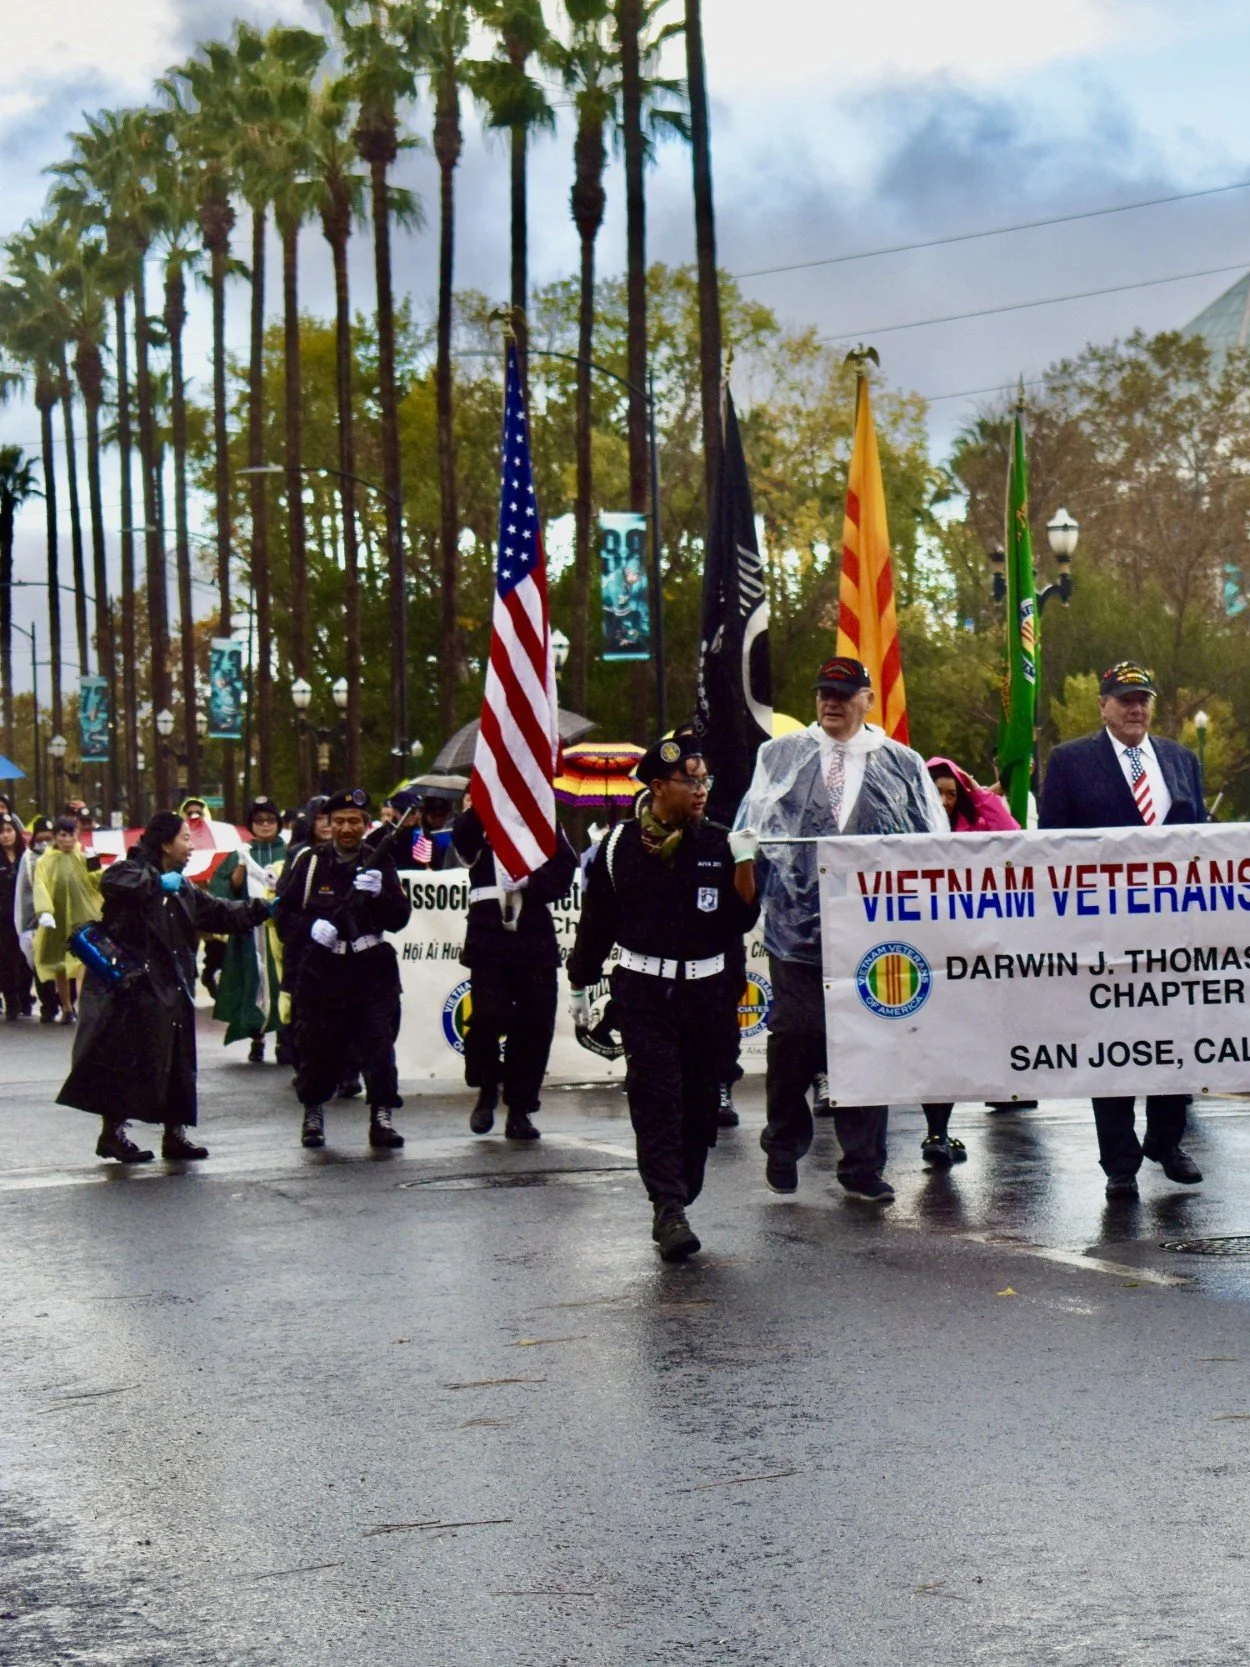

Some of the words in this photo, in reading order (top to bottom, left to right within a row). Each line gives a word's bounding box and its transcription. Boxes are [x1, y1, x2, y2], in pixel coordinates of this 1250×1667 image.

[401, 878, 470, 911] Associ
[857, 866, 1035, 922] VIETNAM
[402, 941, 424, 963] Hội
[858, 946, 887, 986] VIETNAM
[888, 944, 929, 984] VETERANS
[945, 952, 1079, 981] DARWIN
[1088, 951, 1115, 976] J.
[443, 981, 472, 1013] VIETNA
[737, 1005, 769, 1013] CIATES
[865, 996, 880, 1008] OF
[877, 995, 924, 1016] AMERICA
[1089, 978, 1245, 1010] CHAPTER
[740, 1021, 768, 1038] ERICA
[1010, 1043, 1078, 1072] SAN
[1088, 1039, 1184, 1070] JOSE,
